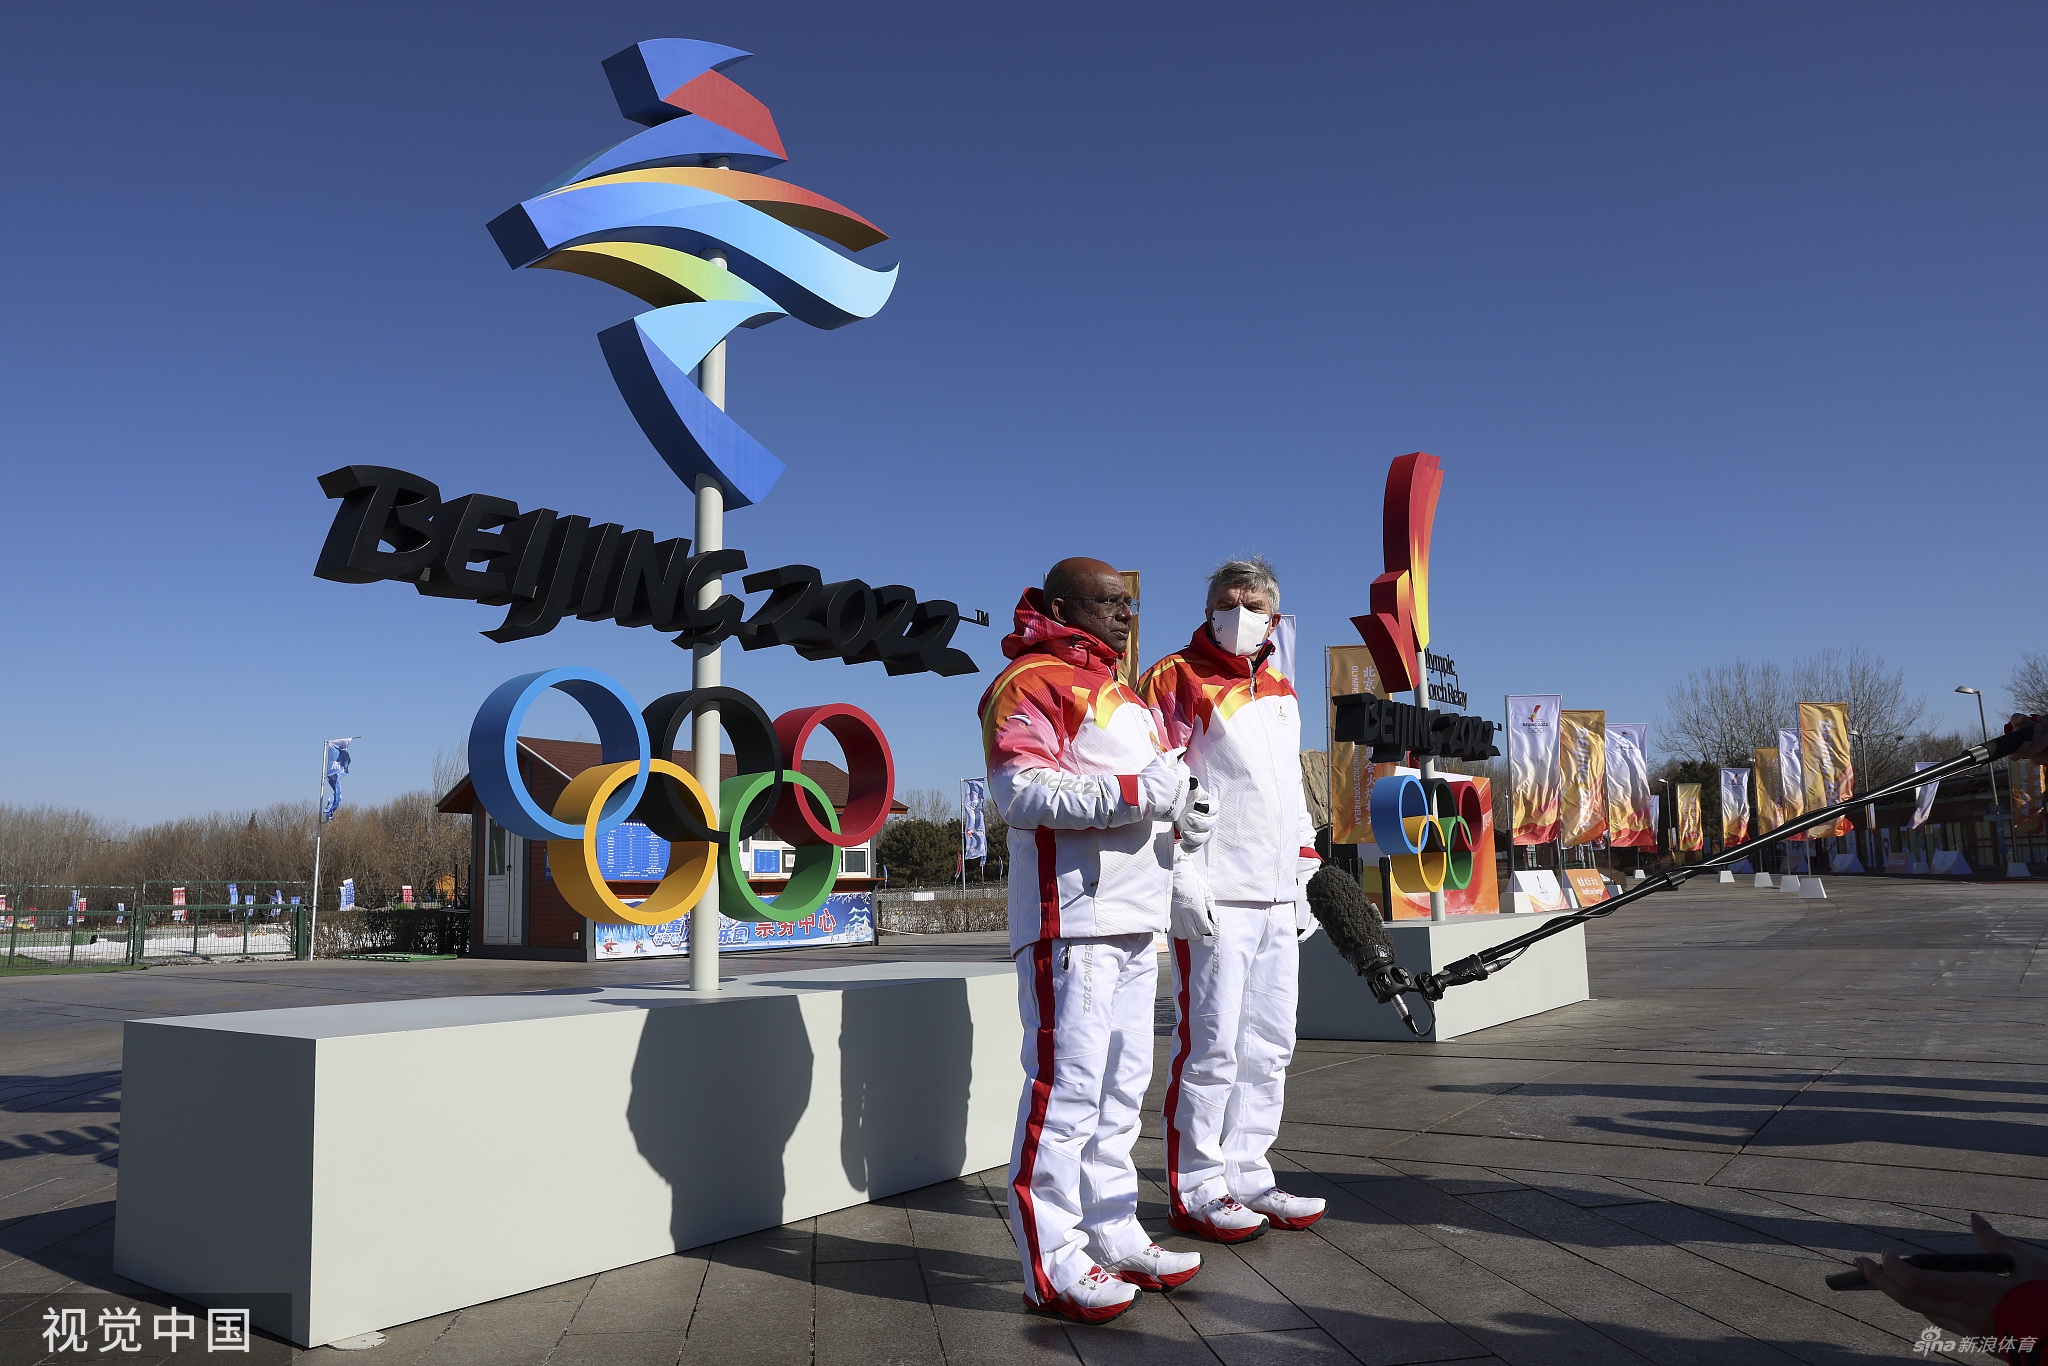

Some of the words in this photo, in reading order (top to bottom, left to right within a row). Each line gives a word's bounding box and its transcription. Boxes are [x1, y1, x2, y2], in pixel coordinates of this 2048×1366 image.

[313, 464, 748, 649] BEIJING
[738, 564, 980, 677] 2022
[1424, 648, 1457, 677] lympic
[1426, 672, 1448, 703] orch
[1332, 692, 1443, 763] BEIJING
[1082, 944, 1094, 982] BEIJING
[1082, 985, 1093, 1015] 2022
